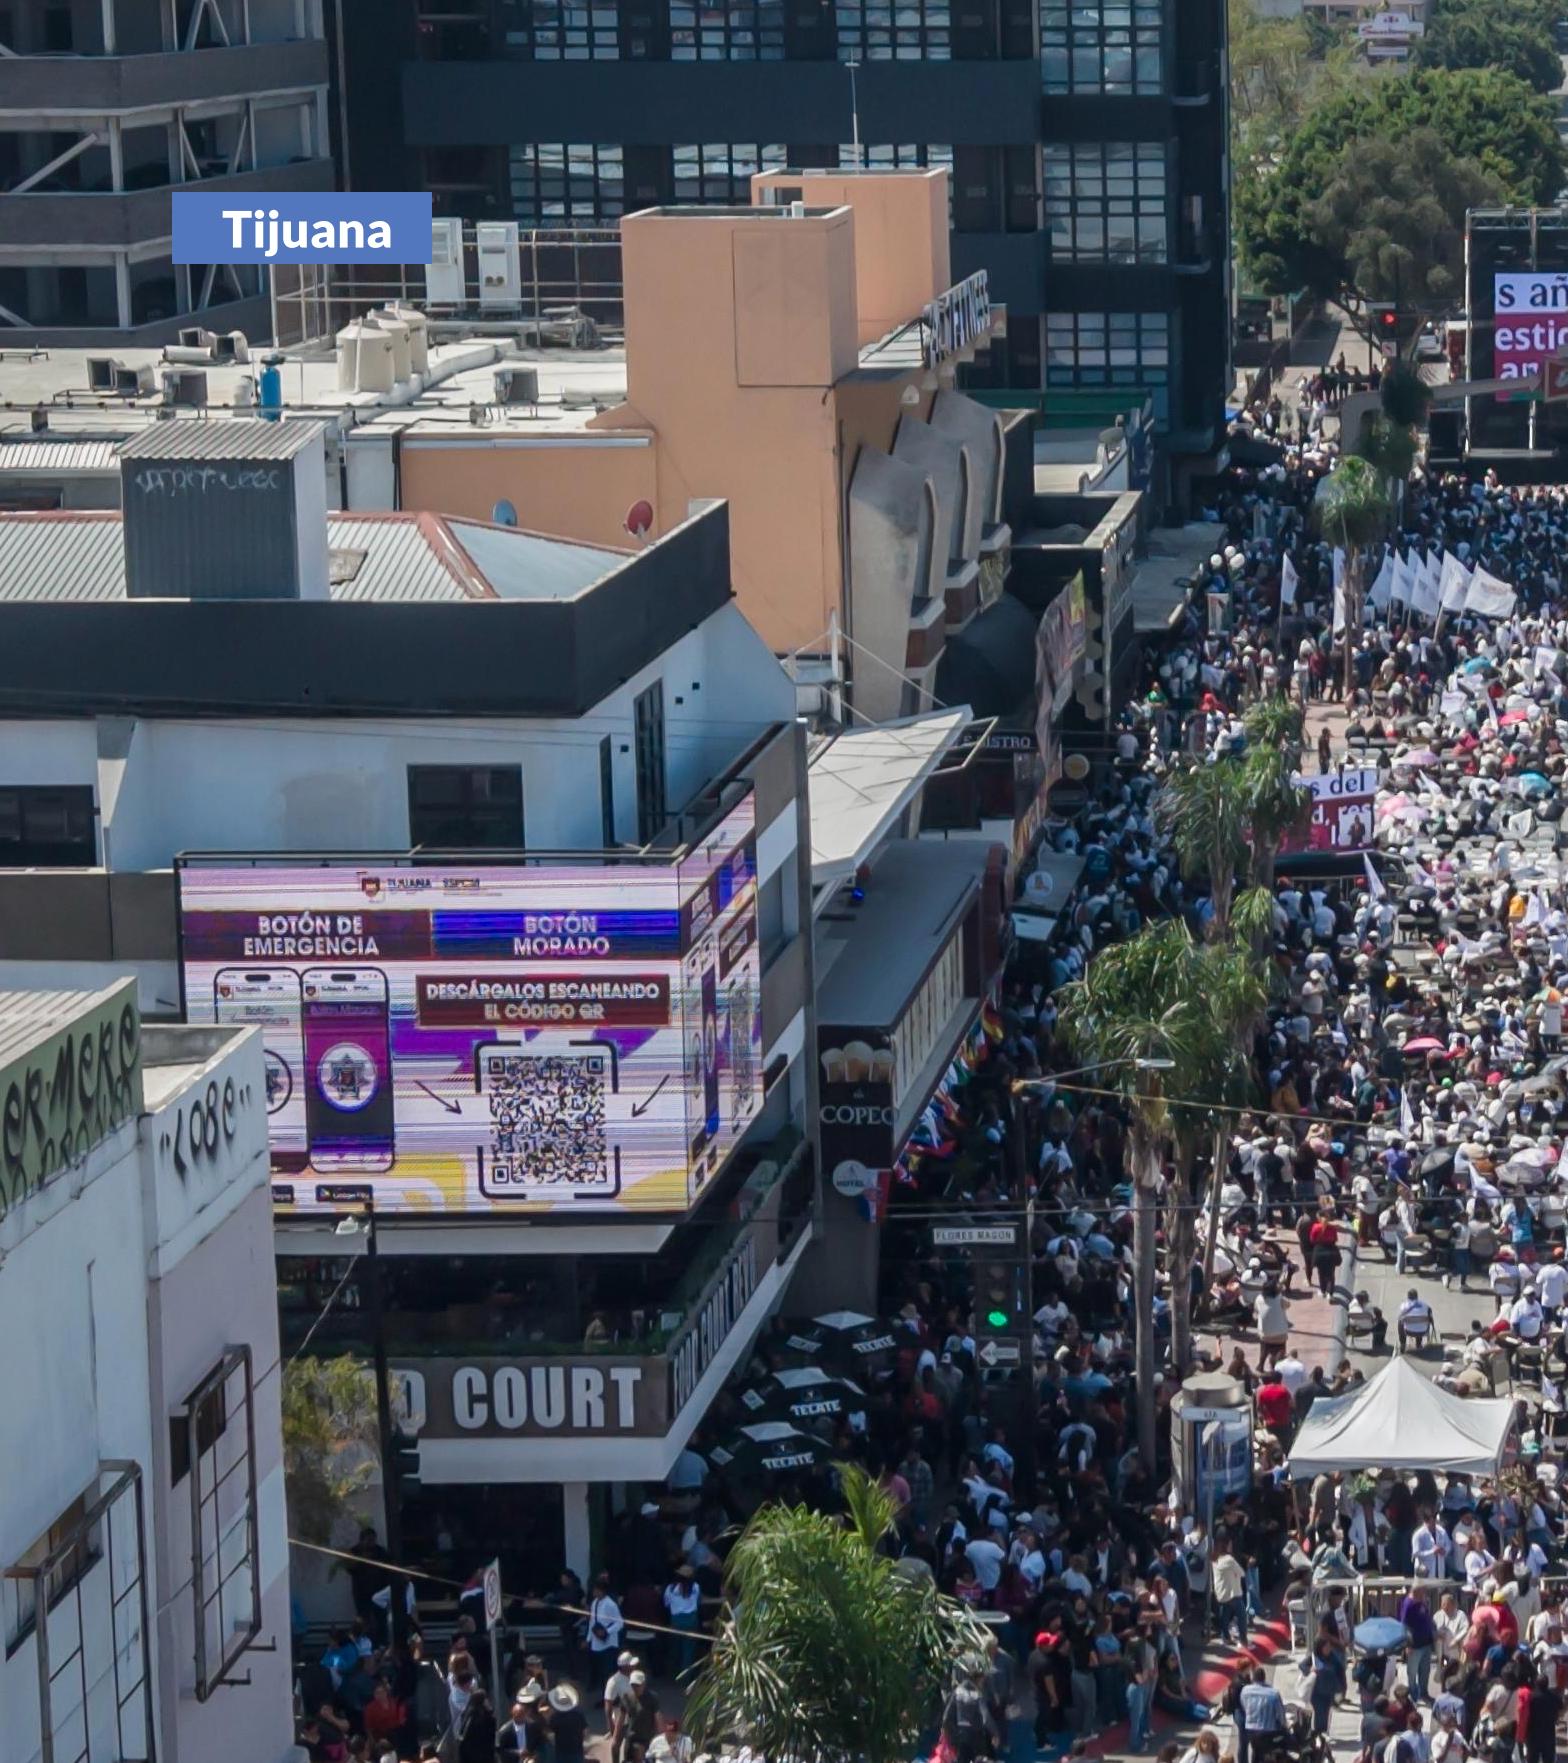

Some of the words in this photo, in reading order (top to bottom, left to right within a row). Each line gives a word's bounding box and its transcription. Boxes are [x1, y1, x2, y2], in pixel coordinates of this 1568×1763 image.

[1330, 771, 1365, 795] del
[259, 911, 330, 935] BOTÓN
[337, 915, 363, 934] DE
[524, 911, 597, 934] BOTÓN
[244, 937, 379, 956] EMERGENCIA
[513, 936, 610, 956] MORADO
[426, 979, 545, 1000] DESCÁRGALOS
[549, 983, 660, 999] ESCANEANDO
[484, 1004, 499, 1020] EL
[504, 1000, 575, 1020] CÓDIGO
[936, 1231, 973, 1241] FLORES
[852, 1335, 897, 1354] TECATE
[452, 1366, 642, 1429] COURT
[790, 1400, 842, 1416] TECATE
[761, 1452, 815, 1470] TECATE
